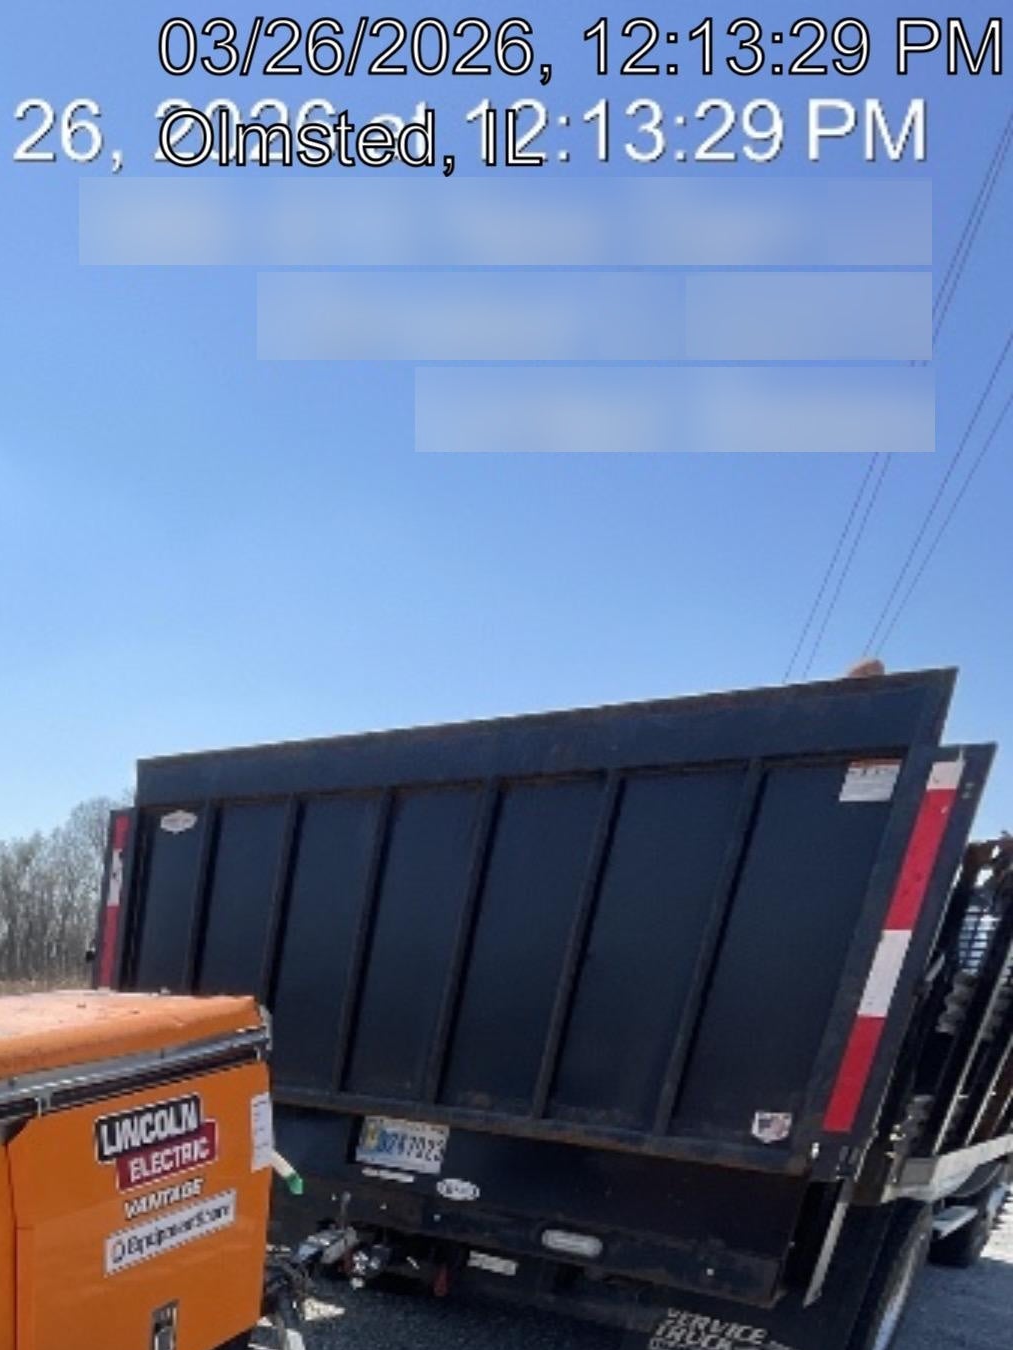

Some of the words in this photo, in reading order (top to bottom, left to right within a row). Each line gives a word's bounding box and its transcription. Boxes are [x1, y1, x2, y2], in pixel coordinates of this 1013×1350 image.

[101, 1099, 199, 1156] LINCOLN
[130, 1136, 210, 1183] ELECTRIC
[123, 1177, 204, 1220] VANTAGE
[665, 1307, 768, 1345] SERVICE
